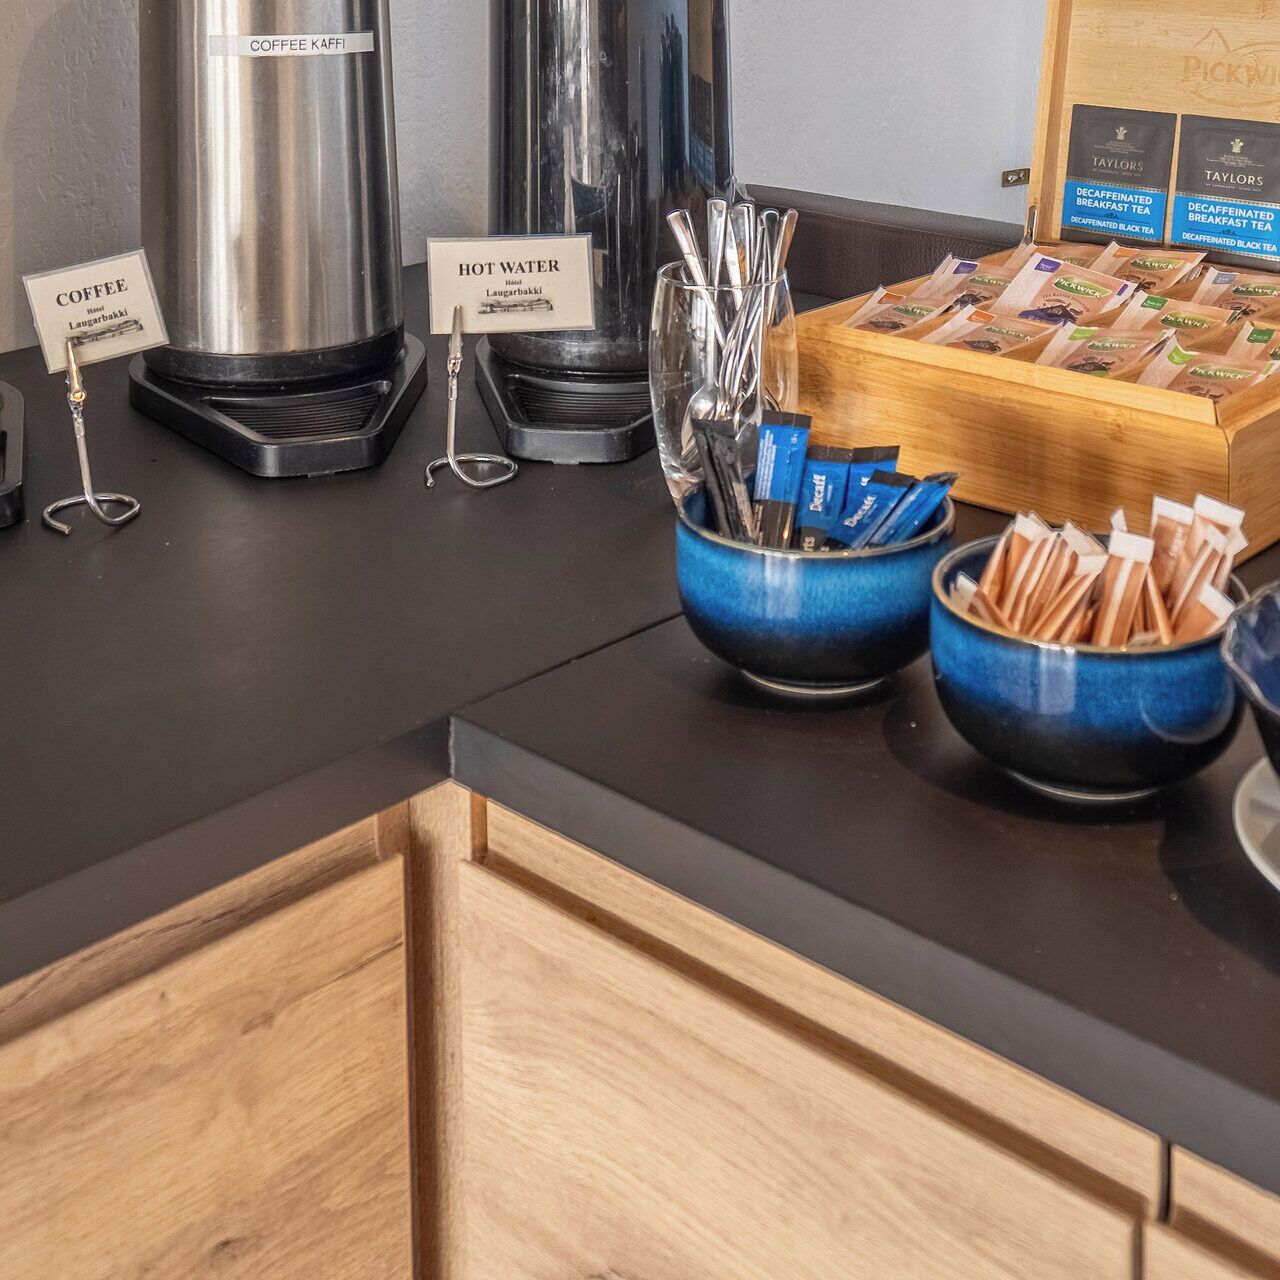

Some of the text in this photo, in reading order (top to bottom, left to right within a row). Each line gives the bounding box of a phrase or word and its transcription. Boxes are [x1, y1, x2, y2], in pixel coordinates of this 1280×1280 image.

[250, 38, 345, 52] COFFEE KAFFI
[1092, 155, 1143, 171] TAYLORS
[1205, 170, 1264, 186] TAYLORS
[1076, 187, 1153, 205] DECAFFEINATED
[1076, 197, 1150, 215] BREAKFAST TEA
[1188, 202, 1275, 220] DECAFFEINATED
[1070, 216, 1154, 235] DECAFFEINATED BLACK TEA
[1188, 213, 1272, 232] BREAKFAST TEA
[1182, 232, 1277, 252] DECAFFEINATED BLACK TEA
[459, 259, 560, 276] HOT WATER
[56, 278, 128, 307] COFFEE
[486, 286, 542, 298] Laugarbakki
[1053, 277, 1103, 299] PICKWICK
[68, 308, 128, 330] Laugarbakki
